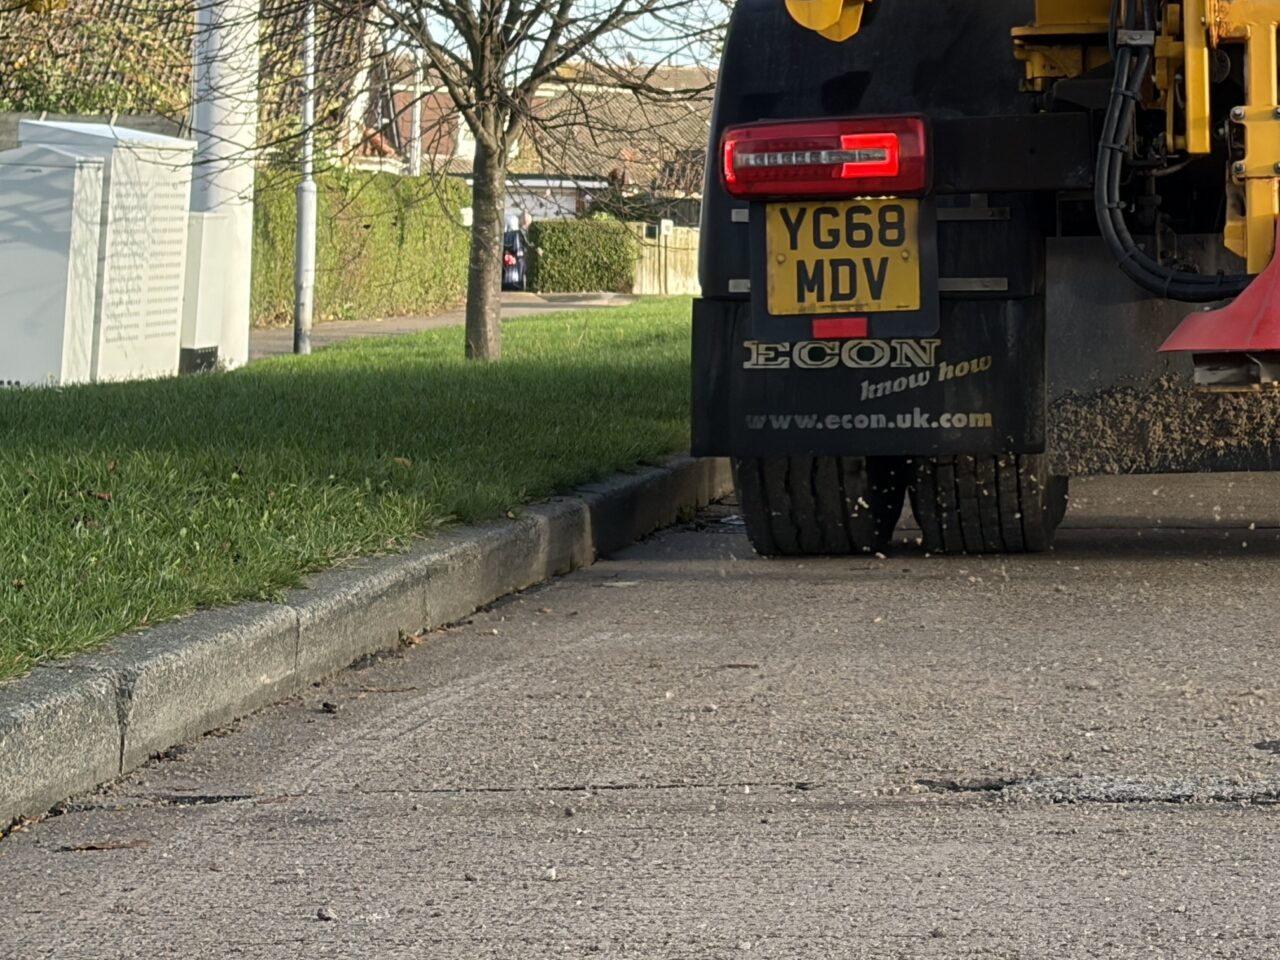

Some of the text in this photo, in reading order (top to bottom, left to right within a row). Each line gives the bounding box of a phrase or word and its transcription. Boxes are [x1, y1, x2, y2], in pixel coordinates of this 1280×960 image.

[780, 204, 905, 251] YG68
[796, 257, 888, 303] MDV
[743, 339, 940, 369] ECON
[861, 354, 993, 401] know how
[746, 407, 993, 430] www.econ.uk.com
